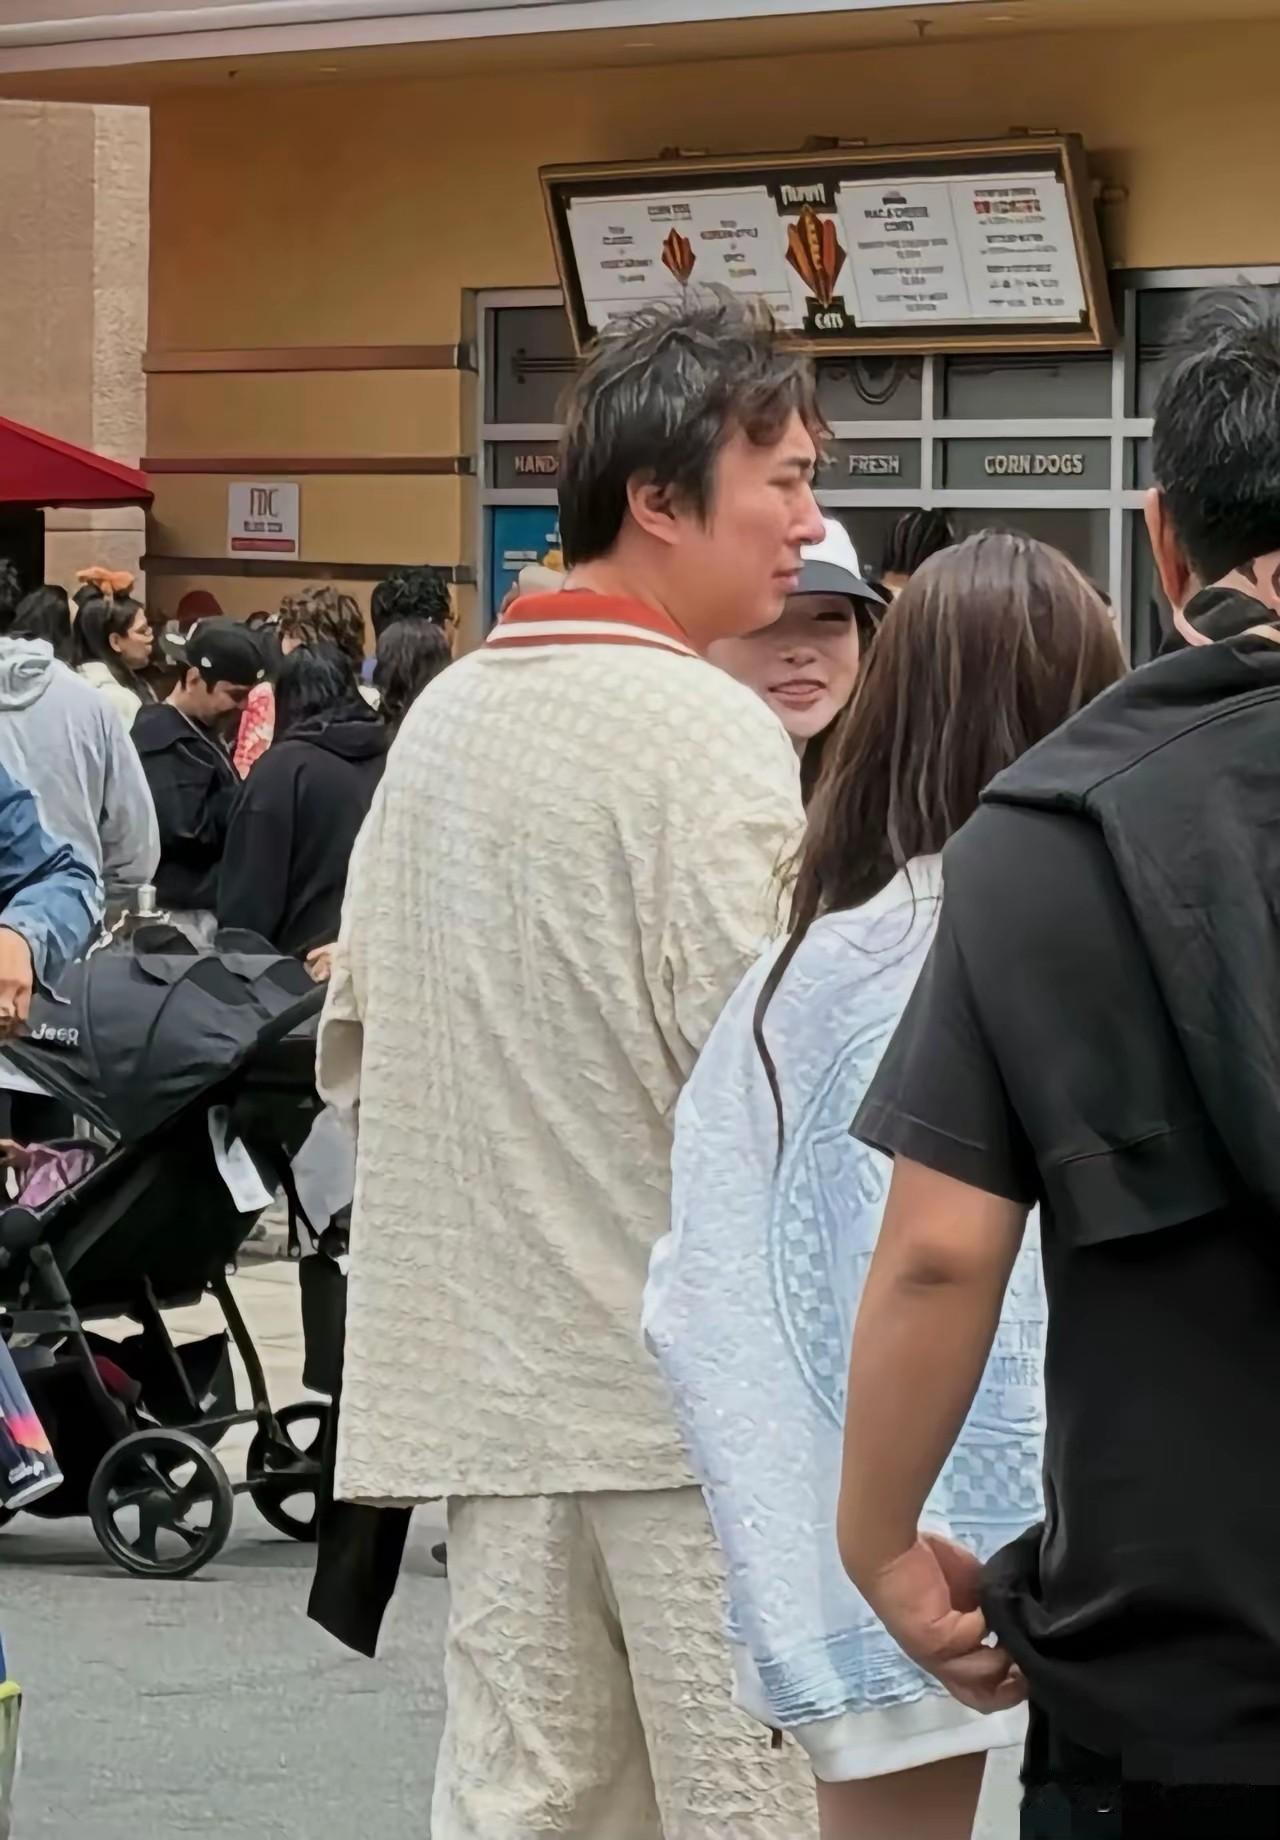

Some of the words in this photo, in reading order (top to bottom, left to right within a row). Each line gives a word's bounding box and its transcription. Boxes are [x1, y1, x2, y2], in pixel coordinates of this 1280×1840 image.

[514, 455, 559, 473] HAND
[849, 455, 900, 474] FRESH
[984, 454, 1031, 474] CORN
[1032, 454, 1083, 474] DOGS
[31, 1023, 79, 1046] Jeep
